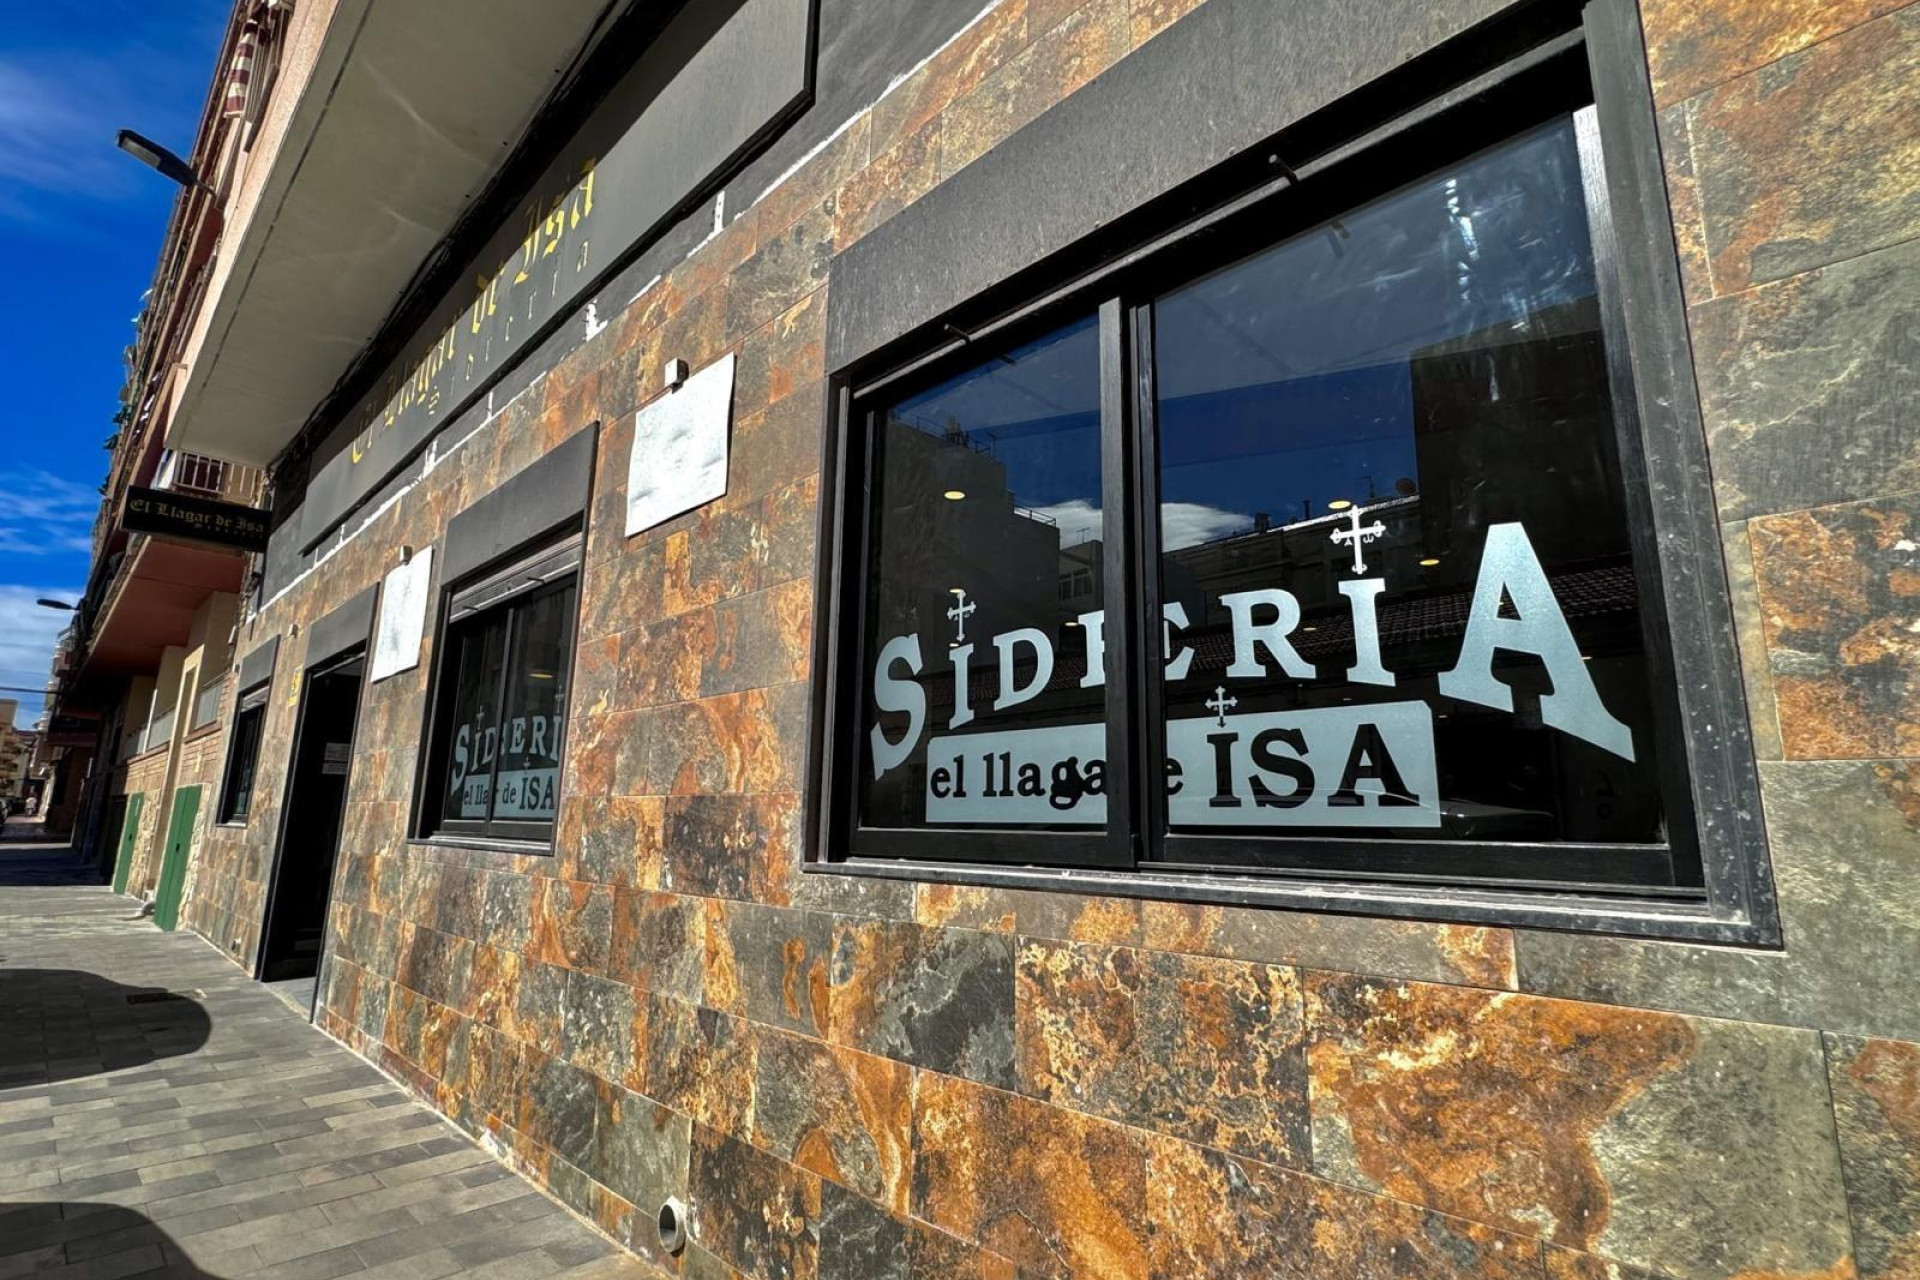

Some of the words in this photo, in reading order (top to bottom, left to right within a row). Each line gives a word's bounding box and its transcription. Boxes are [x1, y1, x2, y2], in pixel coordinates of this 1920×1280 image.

[130, 499, 150, 514] El
[215, 512, 233, 526] de
[870, 522, 1636, 782] SIDRIA
[451, 715, 562, 795] SIDERI
[502, 783, 517, 804] de
[519, 775, 555, 810] ISA
[931, 755, 966, 798] el
[982, 751, 1107, 810] llaga
[1166, 757, 1184, 795] e
[1207, 723, 1420, 808] ISA
